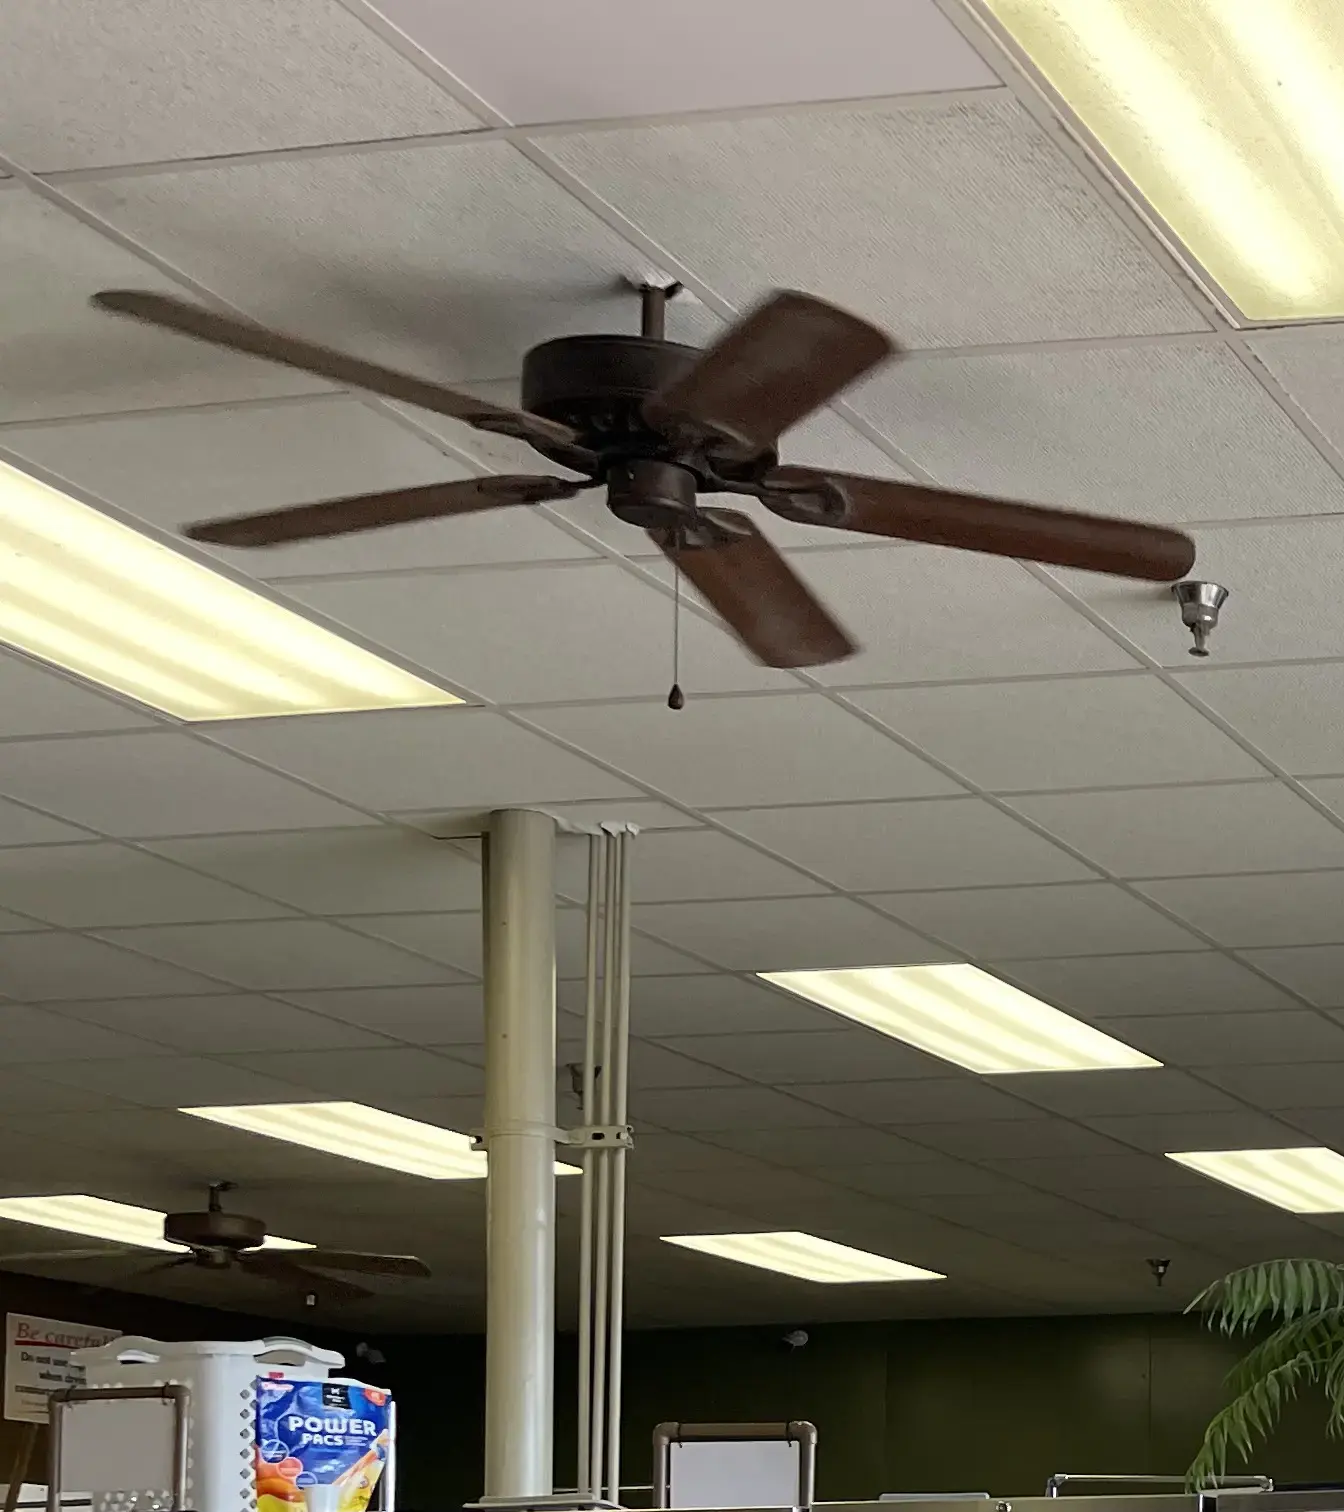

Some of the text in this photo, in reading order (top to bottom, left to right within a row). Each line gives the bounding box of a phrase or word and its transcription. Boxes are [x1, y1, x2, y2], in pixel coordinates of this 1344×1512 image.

[17, 1321, 40, 1339] Be
[288, 1416, 377, 1436] POWER
[301, 1433, 343, 1446] PACS
